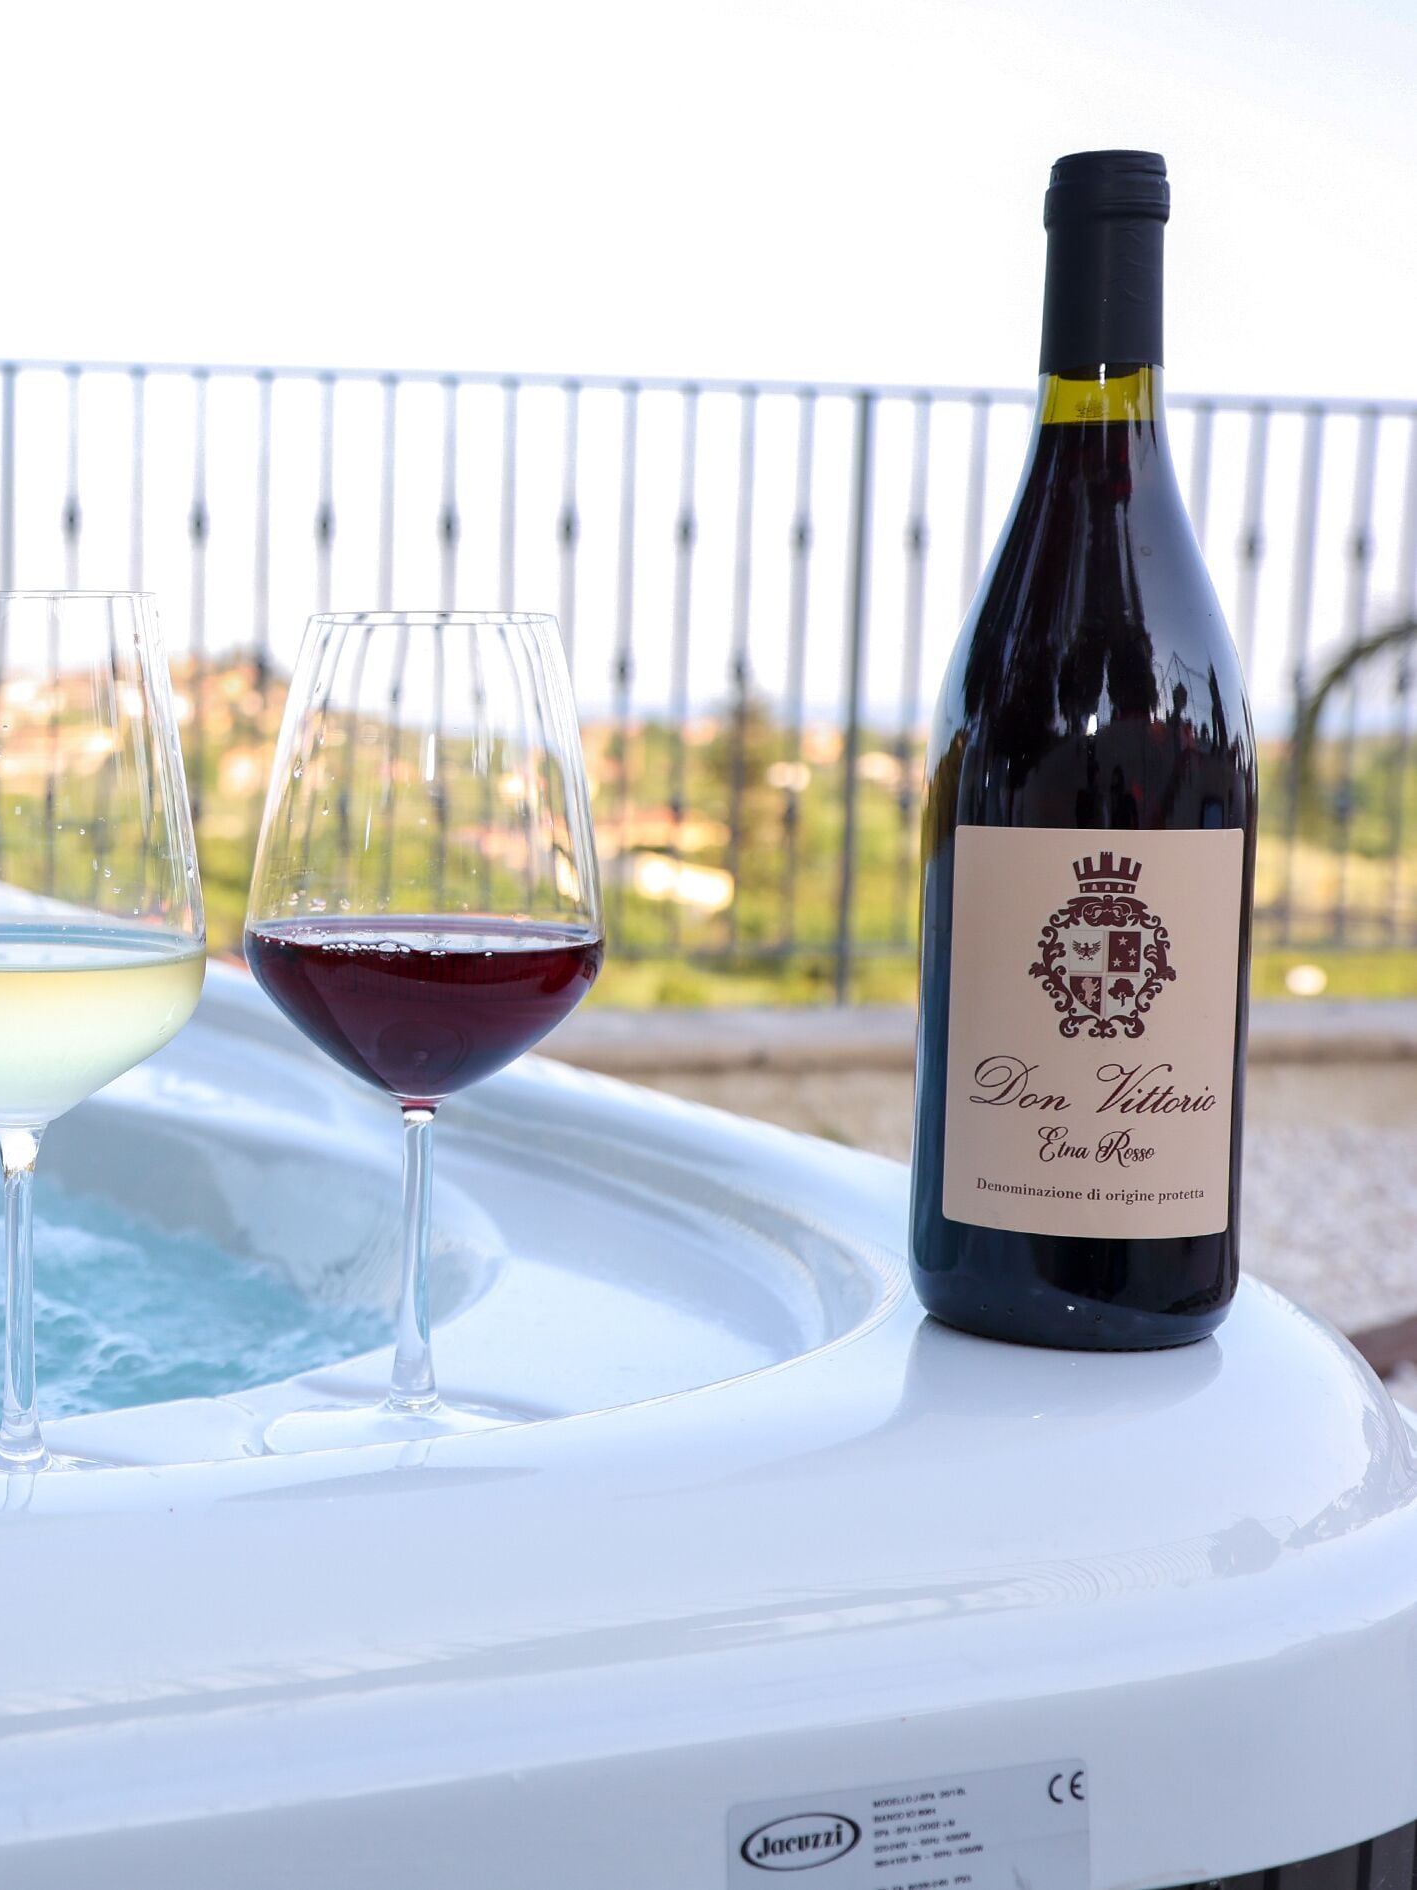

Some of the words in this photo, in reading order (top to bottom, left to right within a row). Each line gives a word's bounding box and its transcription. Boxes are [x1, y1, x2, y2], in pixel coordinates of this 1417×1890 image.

[969, 1055, 1071, 1112] Don
[1095, 1063, 1216, 1114] Vittorio
[1038, 1126, 1090, 1162] Etna
[1095, 1128, 1156, 1168] Rosso
[976, 1177, 1083, 1200] Denominazione
[1087, 1188, 1101, 1201] di
[1105, 1187, 1155, 1205] origine
[1158, 1187, 1204, 1204] protetta
[756, 1823, 843, 1859] Jacuzzi
